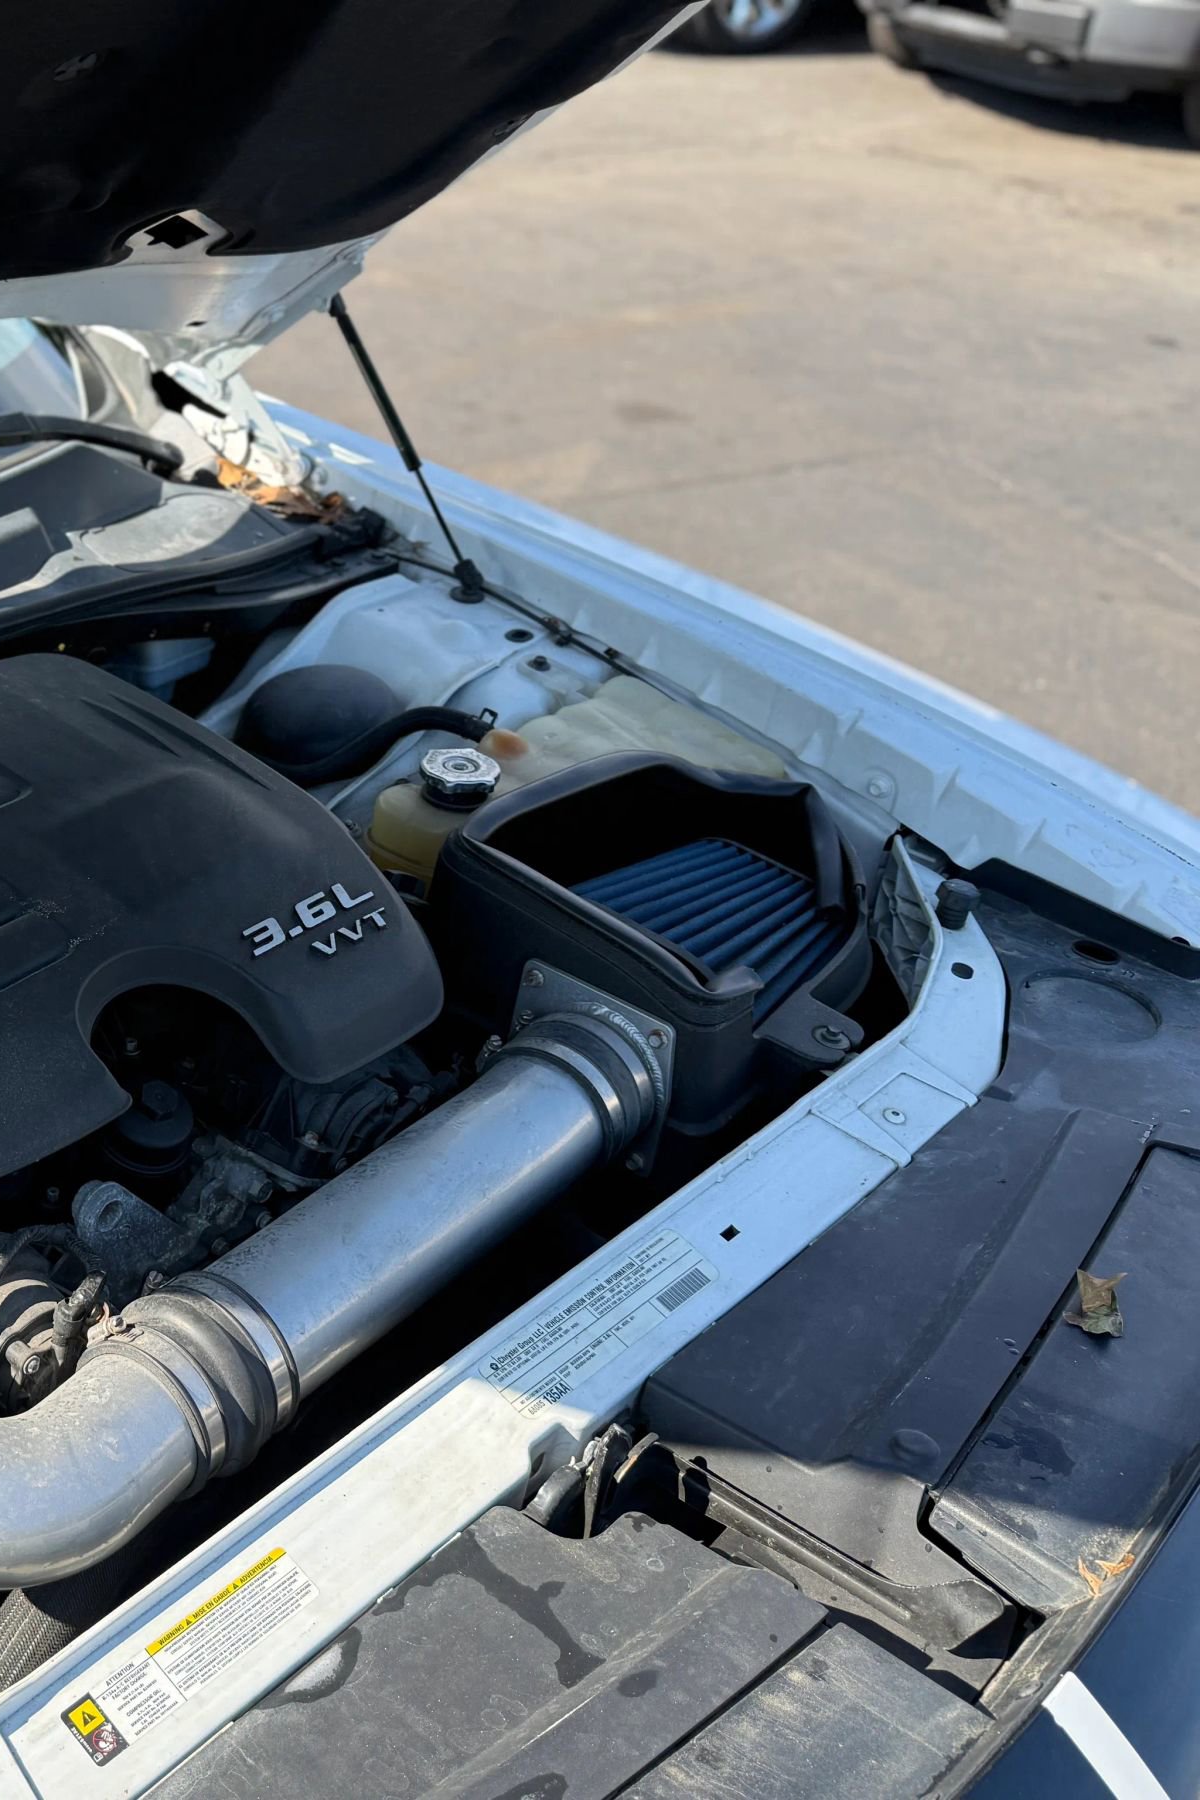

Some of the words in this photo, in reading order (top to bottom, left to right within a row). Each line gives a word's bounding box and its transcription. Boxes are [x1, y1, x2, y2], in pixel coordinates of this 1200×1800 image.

[242, 883, 375, 957] 3.6L
[311, 907, 386, 955] VVT
[542, 1311, 566, 1330] VEHICLE
[561, 1295, 587, 1316] EMISSION
[582, 1281, 607, 1301] CONTROL
[602, 1260, 637, 1286] INFORMATION
[495, 1344, 520, 1364] Chrysler
[515, 1334, 536, 1350] Group
[530, 1327, 545, 1339] LLC
[540, 1380, 571, 1406] 135AA
[156, 1622, 185, 1646] WARNING
[191, 1605, 207, 1620] MISE
[204, 1599, 215, 1610] EN
[211, 1587, 232, 1604] GARDE
[238, 1555, 274, 1584] ADVERTENCIA
[104, 1661, 135, 1687] ATTENTION
